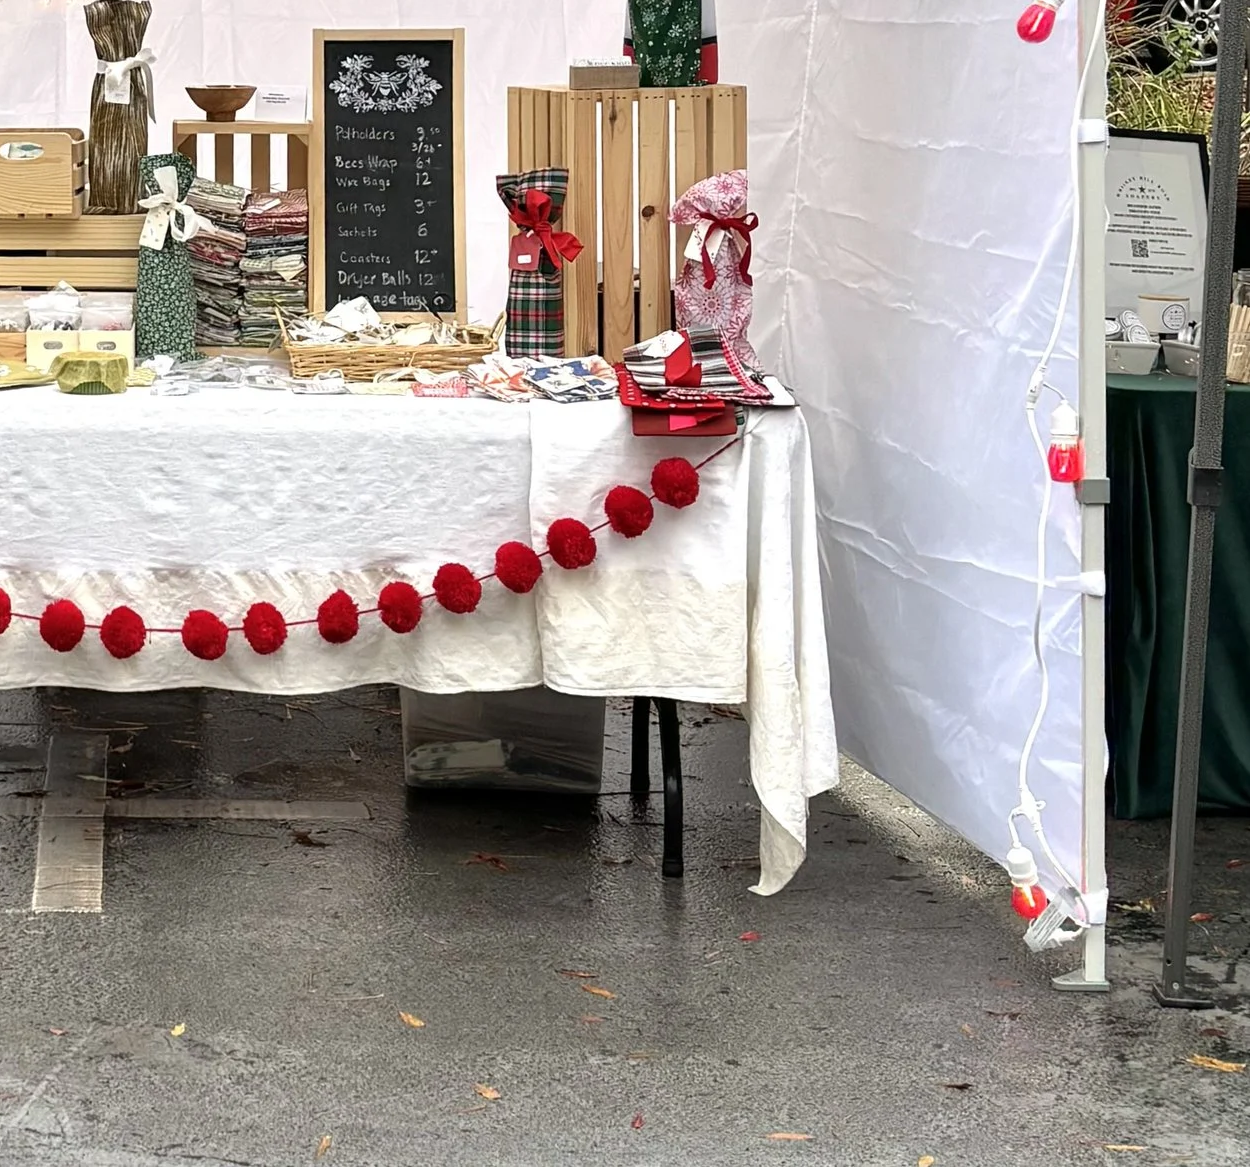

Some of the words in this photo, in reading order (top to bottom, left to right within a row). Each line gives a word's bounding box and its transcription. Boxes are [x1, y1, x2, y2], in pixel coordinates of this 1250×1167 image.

[335, 125, 395, 141] Potholders
[335, 155, 364, 169] Bees
[367, 154, 398, 174] Wrap
[362, 176, 391, 191] Bags
[415, 172, 432, 185] 12
[336, 202, 358, 214] Gift
[363, 202, 386, 217] Tags
[338, 225, 378, 237] Sachets
[417, 222, 428, 237] 6
[340, 251, 391, 264] Coasters
[337, 270, 377, 288] Dryer
[381, 270, 411, 286] Balls
